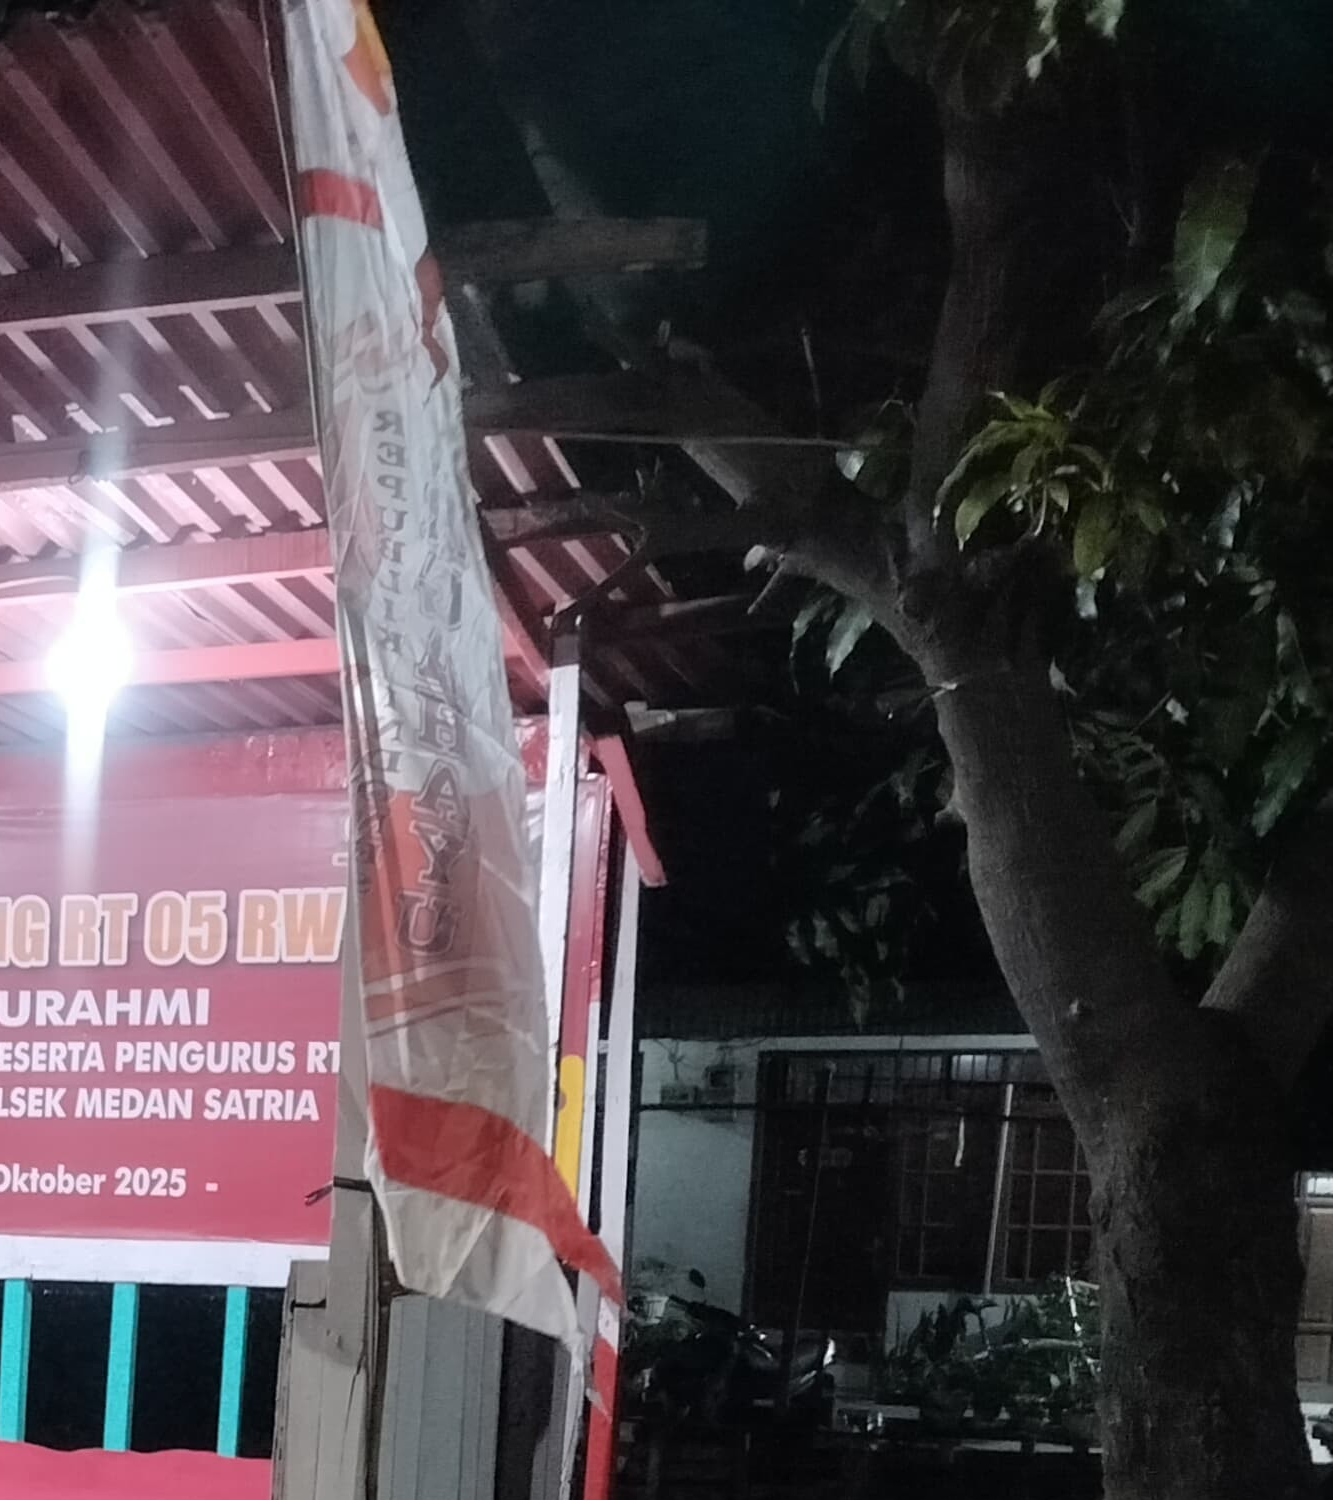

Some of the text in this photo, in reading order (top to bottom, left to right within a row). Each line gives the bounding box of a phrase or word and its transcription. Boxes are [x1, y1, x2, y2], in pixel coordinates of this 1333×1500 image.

[57, 890, 139, 967] RT
[141, 888, 227, 965] 05
[235, 886, 348, 965] RW
[115, 1042, 296, 1074] PENGURUS
[306, 1041, 341, 1074] RT
[74, 1088, 194, 1120] MEDAN
[201, 1089, 321, 1121] SATRIA
[113, 1168, 188, 1198] 2025
